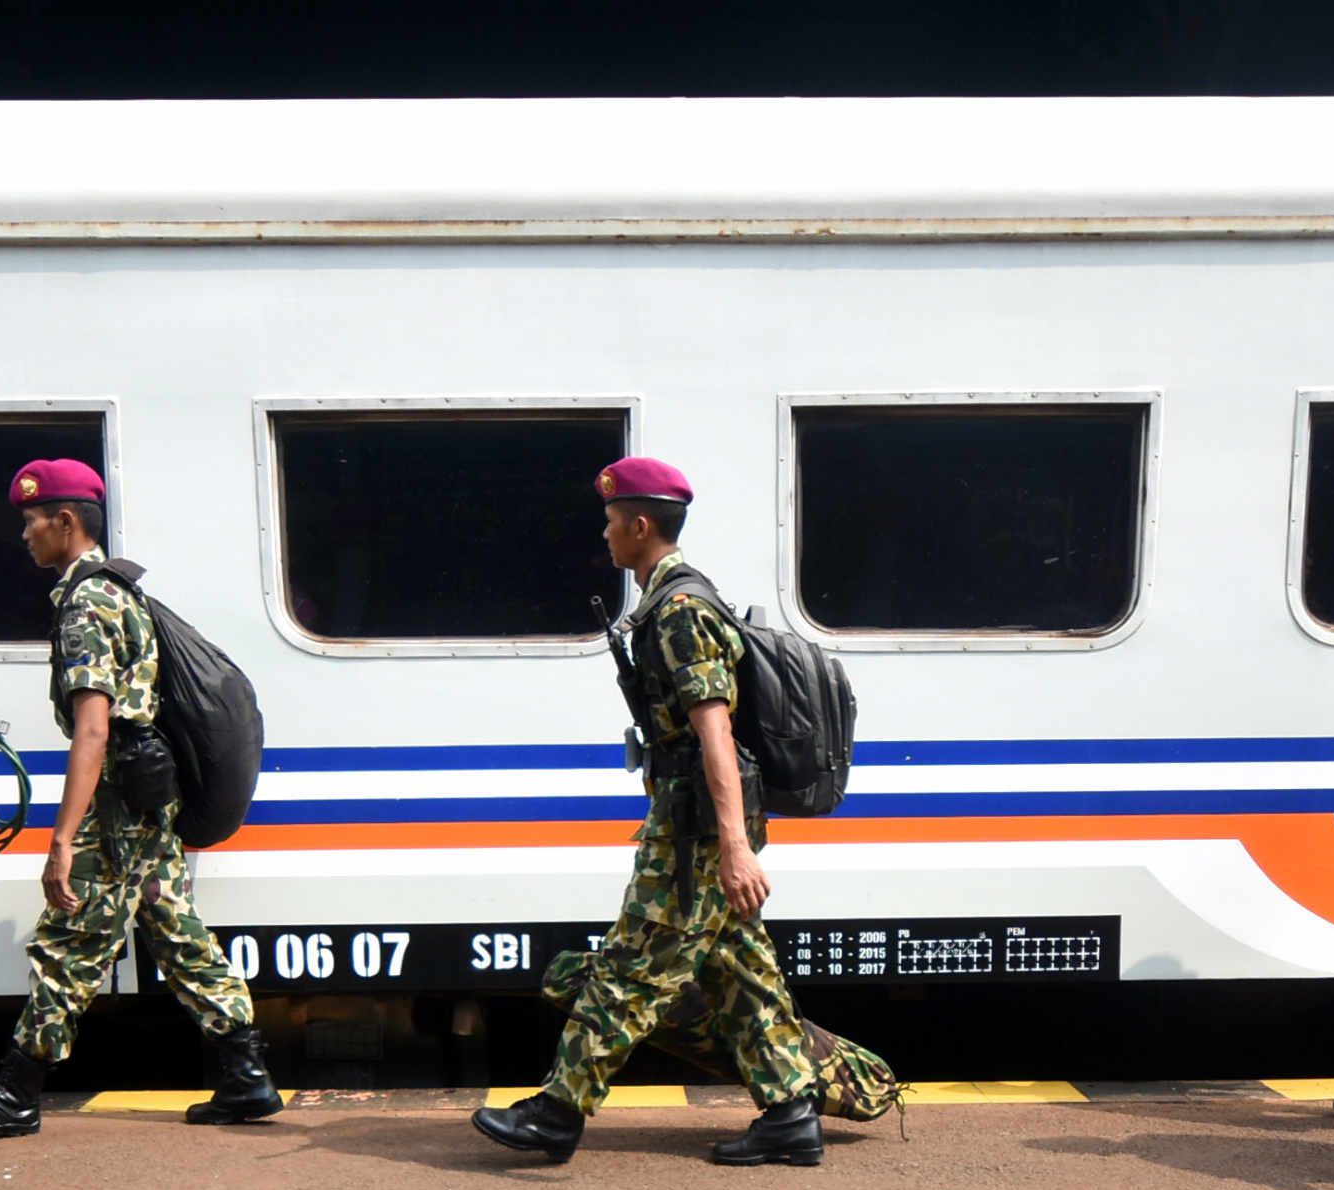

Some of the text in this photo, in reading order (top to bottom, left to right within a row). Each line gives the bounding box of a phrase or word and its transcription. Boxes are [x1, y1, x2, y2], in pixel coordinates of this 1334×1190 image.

[797, 932, 811, 944] 31
[828, 932, 843, 944] 12
[859, 931, 886, 943] 2006
[276, 933, 334, 978] 06
[352, 932, 410, 977] 07
[471, 933, 531, 970] SBI
[797, 948, 811, 960] 08
[828, 947, 842, 959] 10
[858, 947, 886, 959] 2015
[828, 963, 842, 975] 10
[858, 963, 886, 975] 2017
